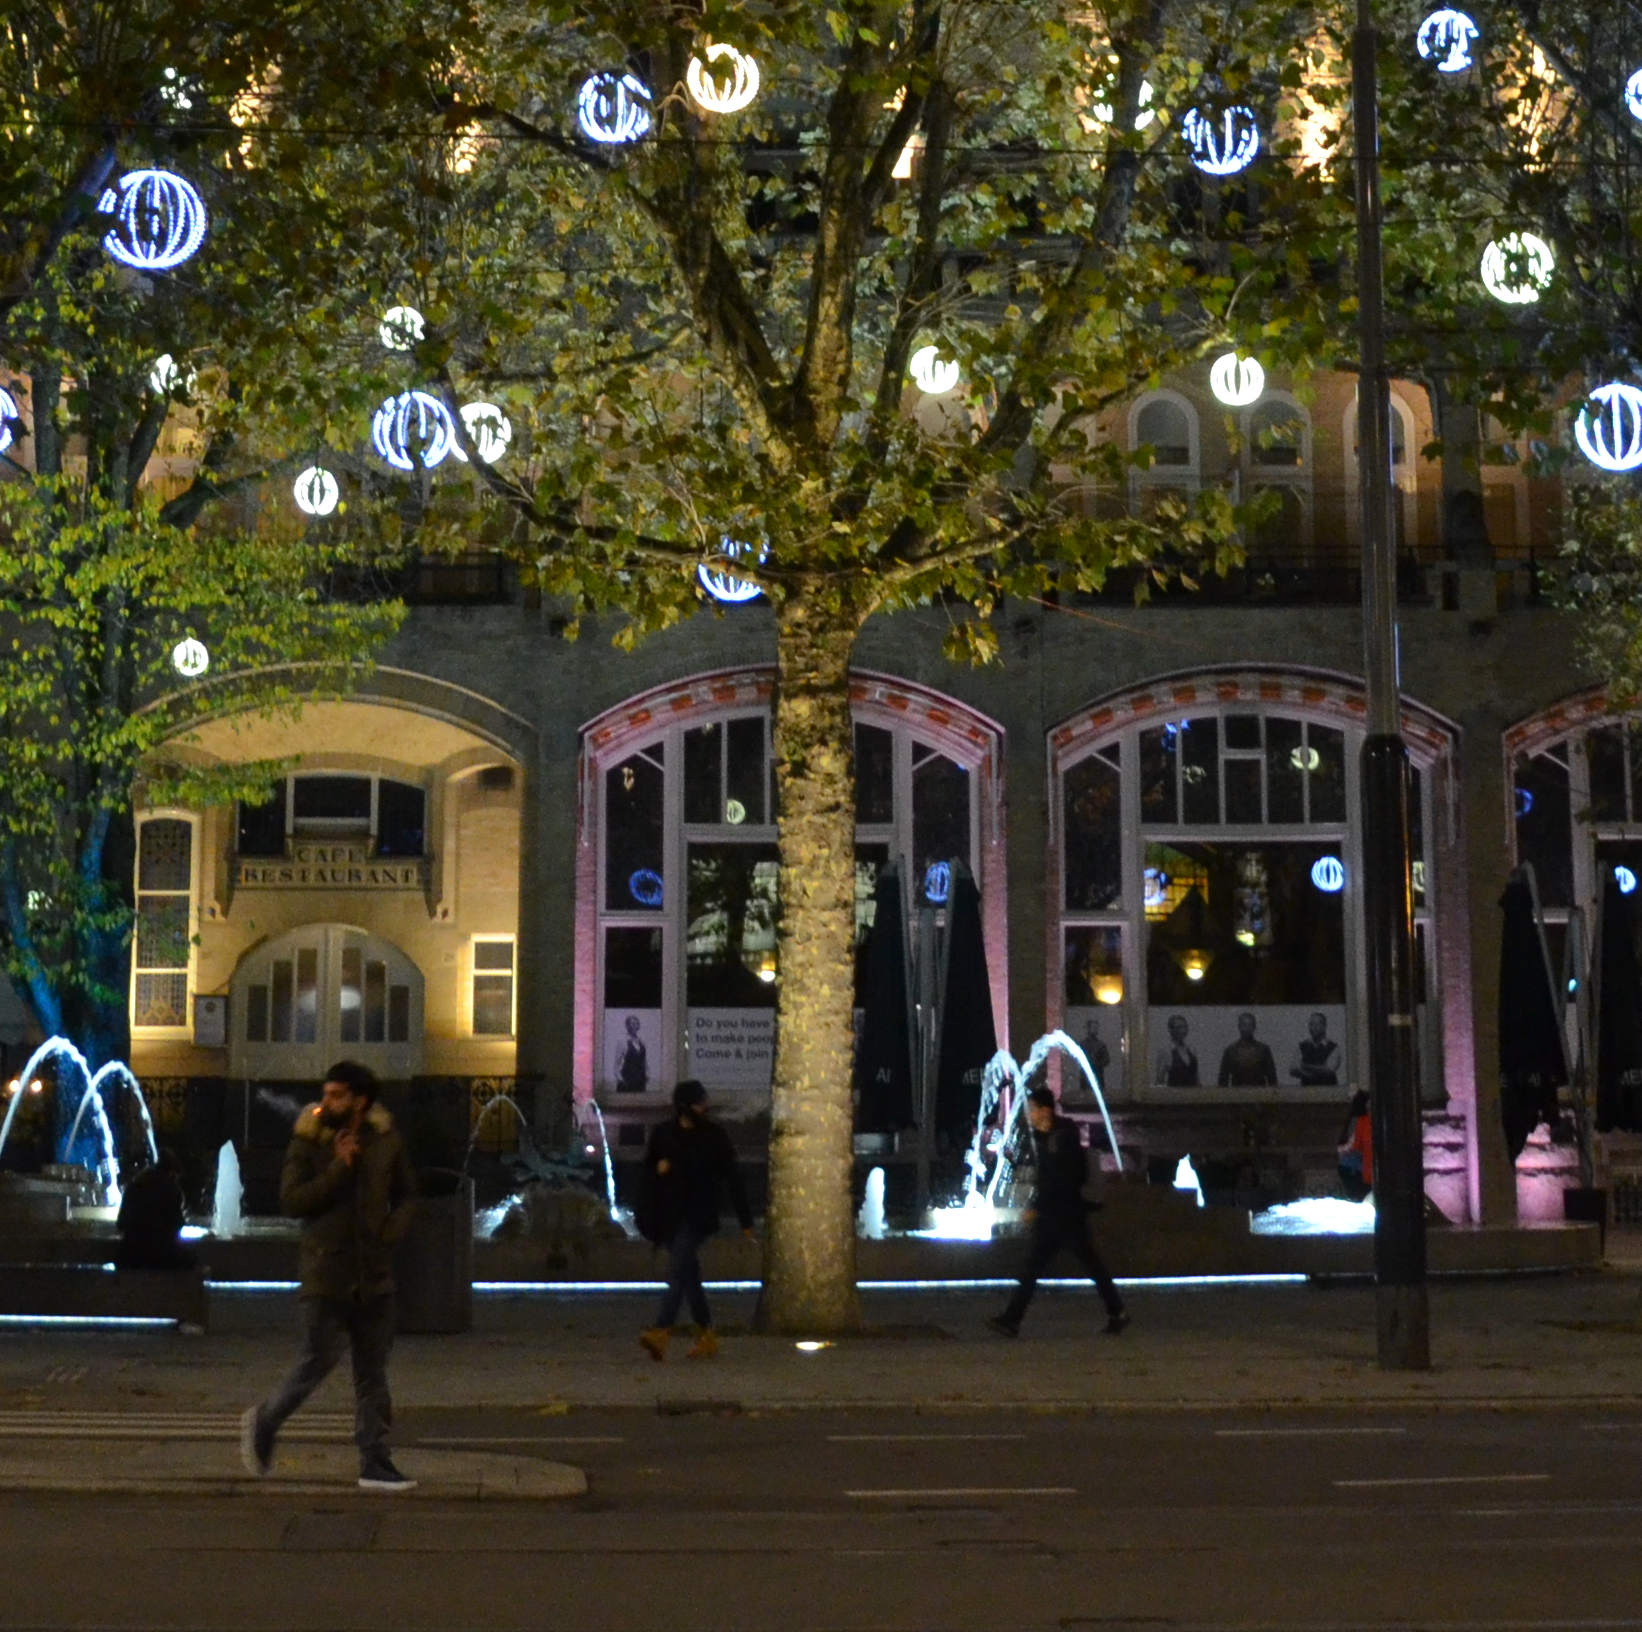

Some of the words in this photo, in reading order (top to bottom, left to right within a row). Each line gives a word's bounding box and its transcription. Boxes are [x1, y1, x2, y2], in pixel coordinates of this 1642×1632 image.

[243, 868, 416, 884] RESTAURANT
[696, 1017, 712, 1028] Do
[716, 1020, 738, 1031] you
[741, 1017, 770, 1029] have
[696, 1033, 708, 1043] to
[711, 1032, 744, 1044] make
[695, 1048, 731, 1060] Come
